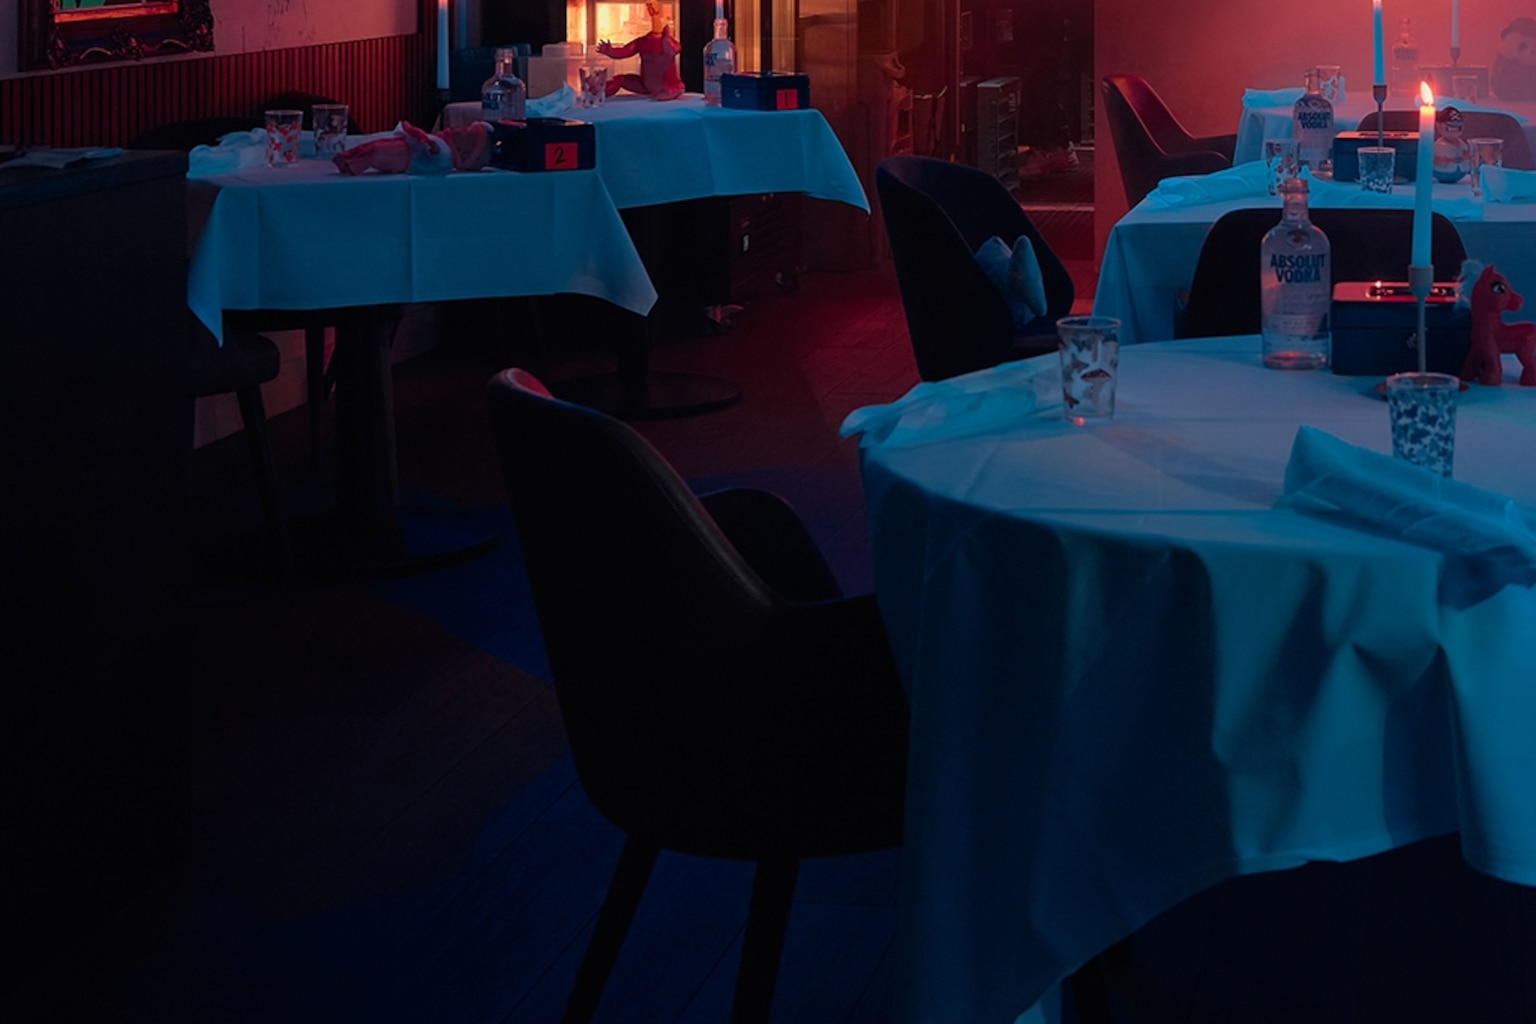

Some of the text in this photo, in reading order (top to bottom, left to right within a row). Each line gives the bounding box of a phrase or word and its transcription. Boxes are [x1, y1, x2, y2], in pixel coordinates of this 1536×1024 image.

[553, 146, 567, 164] 2
[1270, 253, 1326, 268] ABSOLUT
[1275, 267, 1321, 283] VODKA
